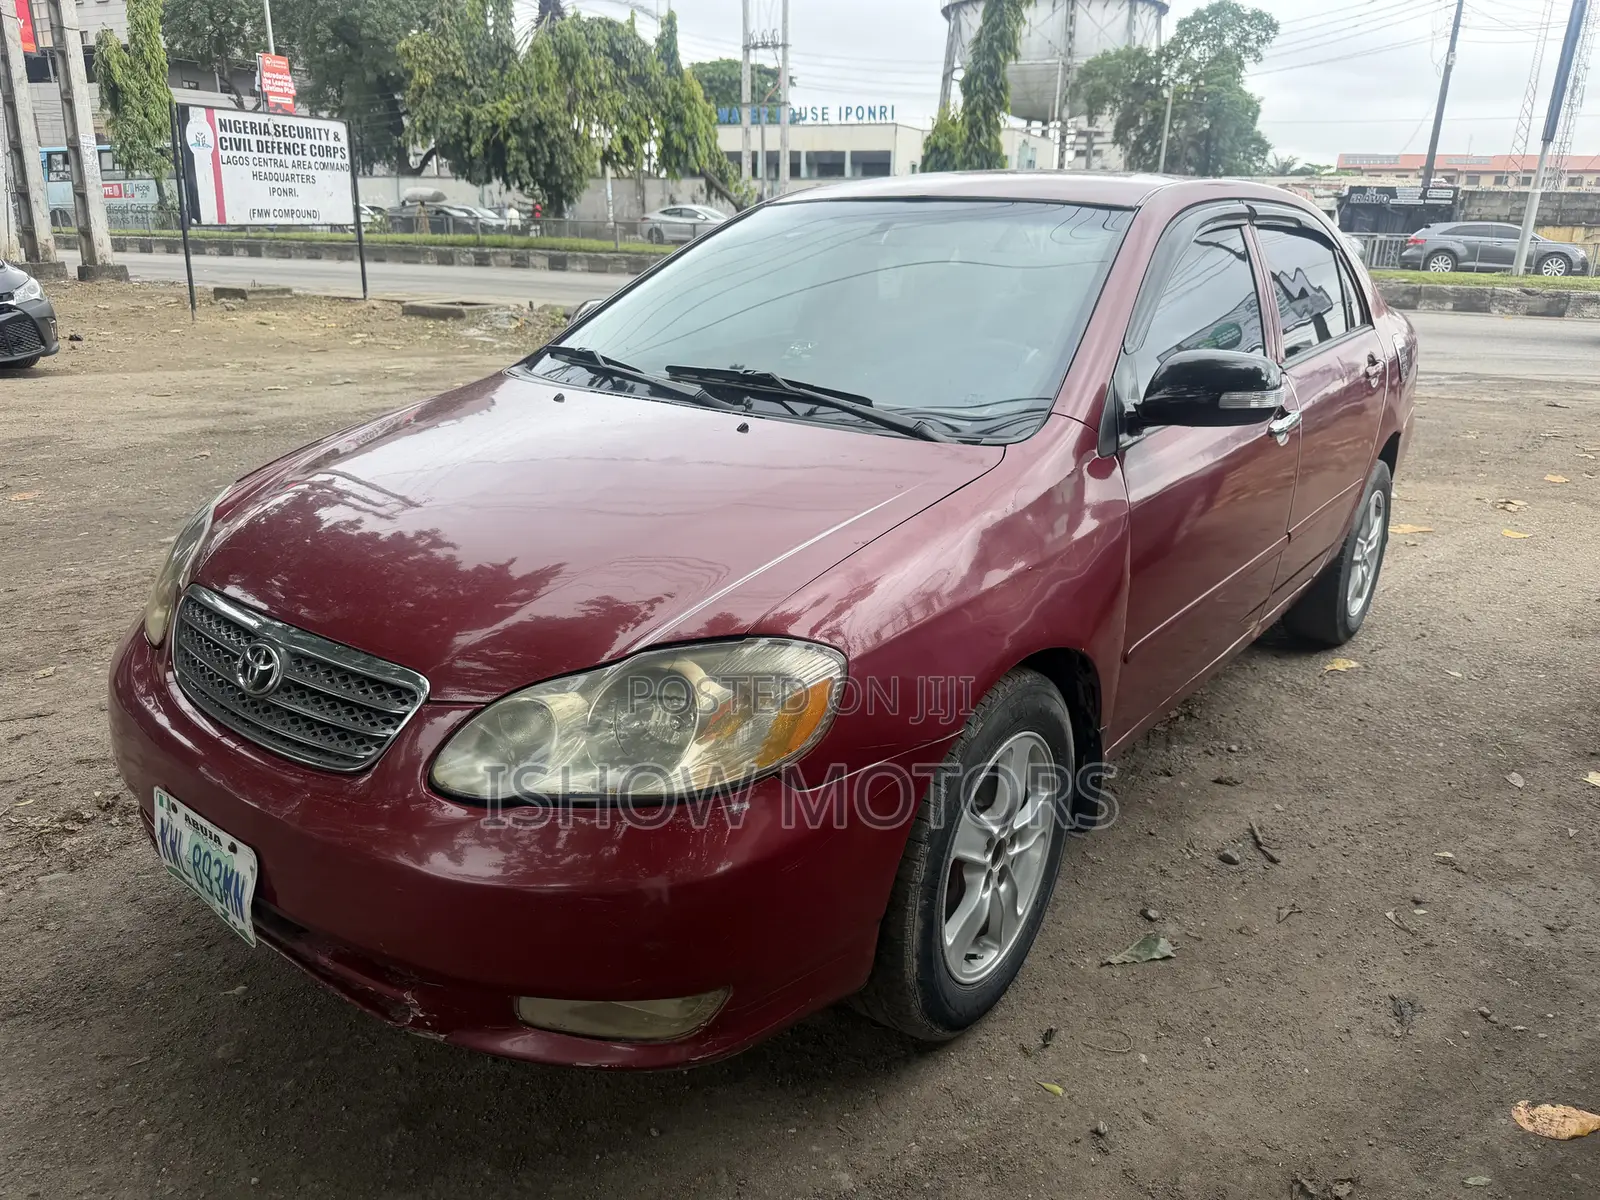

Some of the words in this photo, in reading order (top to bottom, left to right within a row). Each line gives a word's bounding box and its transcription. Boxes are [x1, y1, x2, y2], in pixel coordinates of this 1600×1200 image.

[838, 104, 895, 121] IPONRI
[218, 118, 271, 137] NIGERIA
[273, 123, 330, 141] SECURITY
[333, 131, 341, 142] &
[218, 136, 253, 152] CIVIL
[256, 139, 307, 156] DEFENCE
[309, 143, 346, 160] CORPS
[220, 155, 250, 166] LAGOS
[252, 156, 289, 169] CENTRAL
[291, 159, 312, 170] AREA
[314, 161, 350, 172] COMMAND
[252, 171, 316, 184] HEADQUARTERS
[268, 186, 299, 198] IPONRI.
[249, 208, 271, 220] (FMW
[272, 208, 320, 221] COMPOUND)
